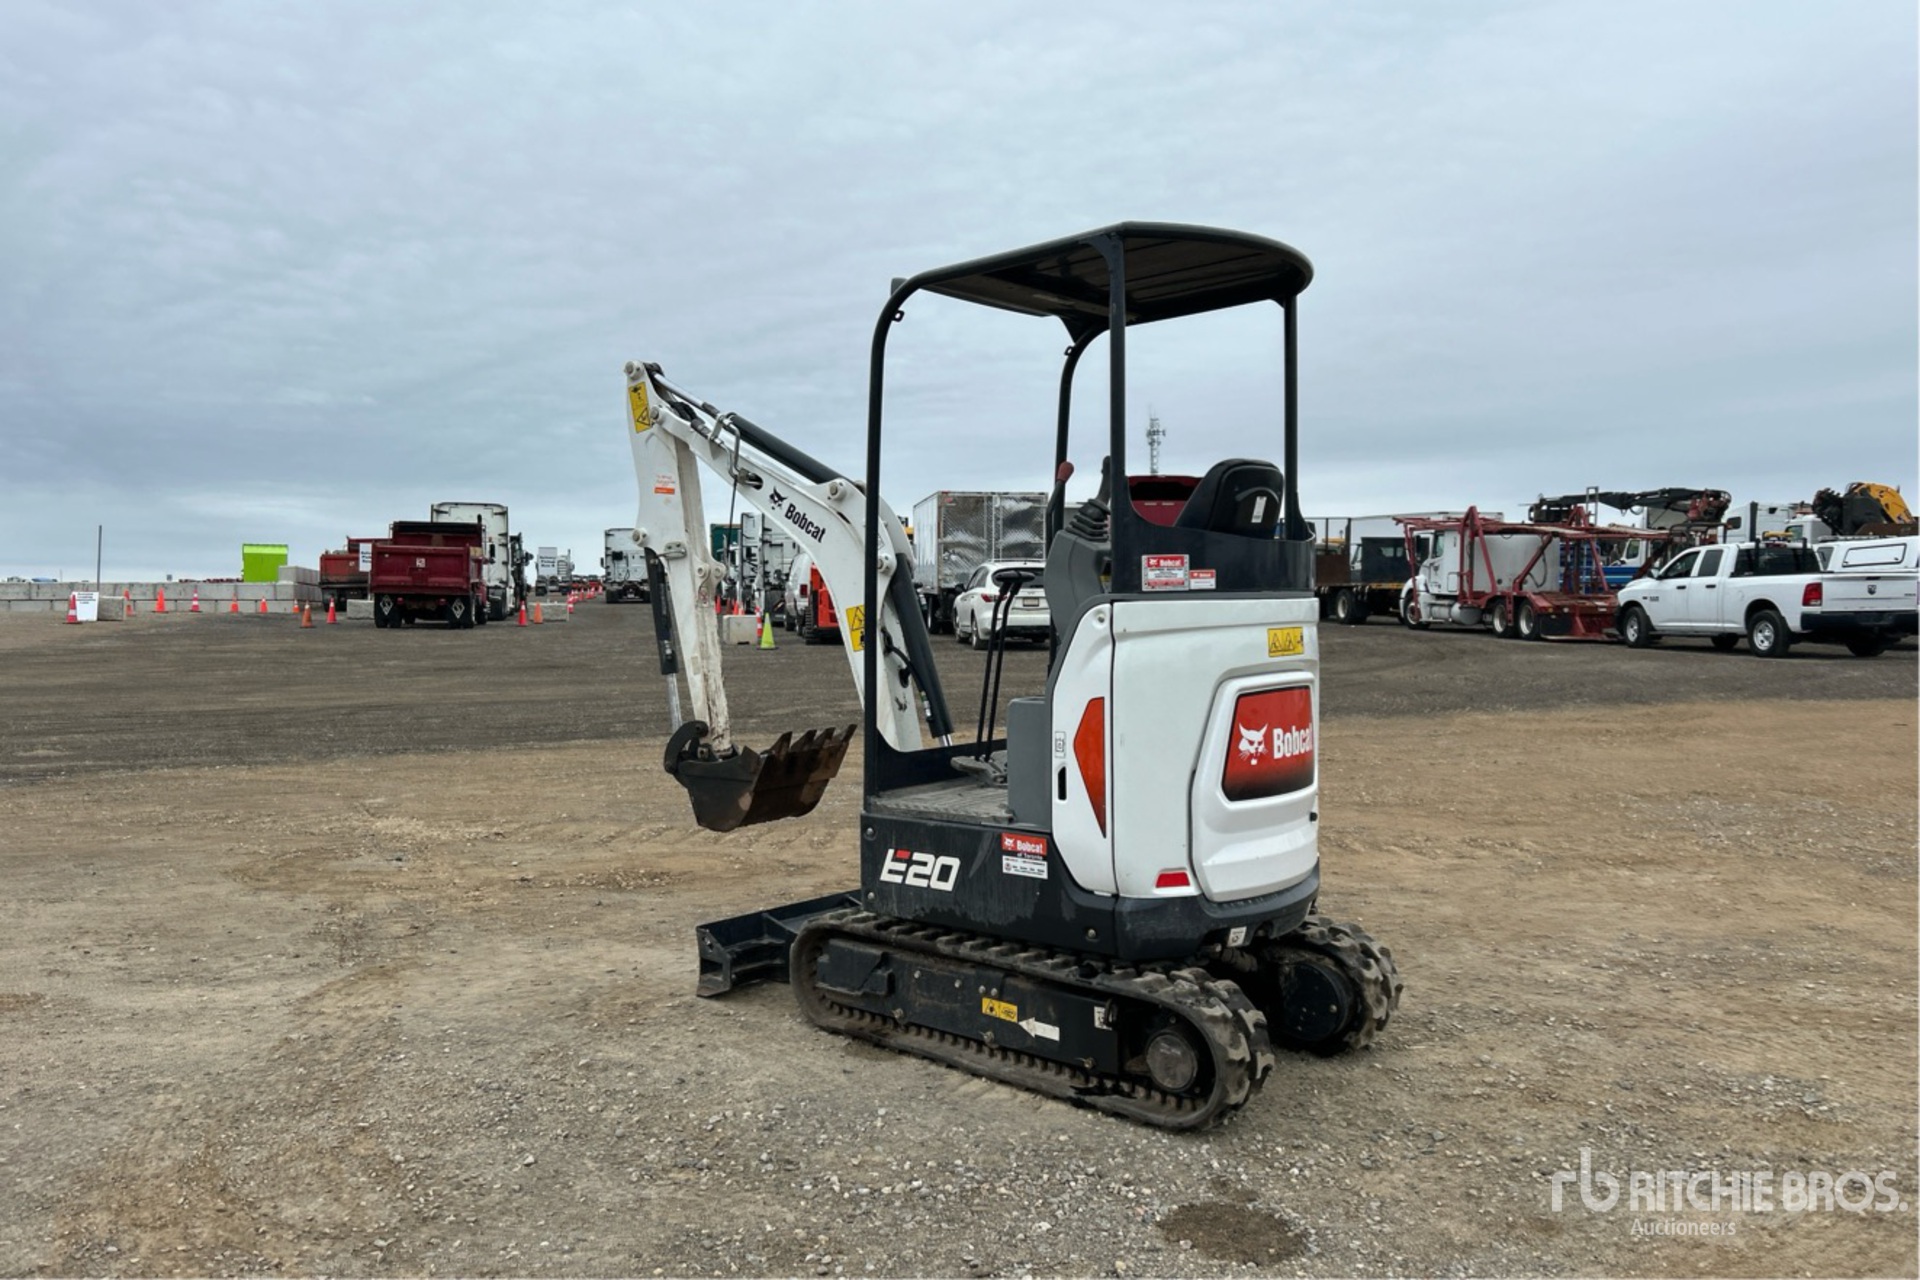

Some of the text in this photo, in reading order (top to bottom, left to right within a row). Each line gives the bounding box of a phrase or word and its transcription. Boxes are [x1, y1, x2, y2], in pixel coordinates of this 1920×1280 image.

[785, 503, 826, 543] Bobcat
[1017, 839, 1042, 854] Bobcat
[880, 848, 961, 892] E20
